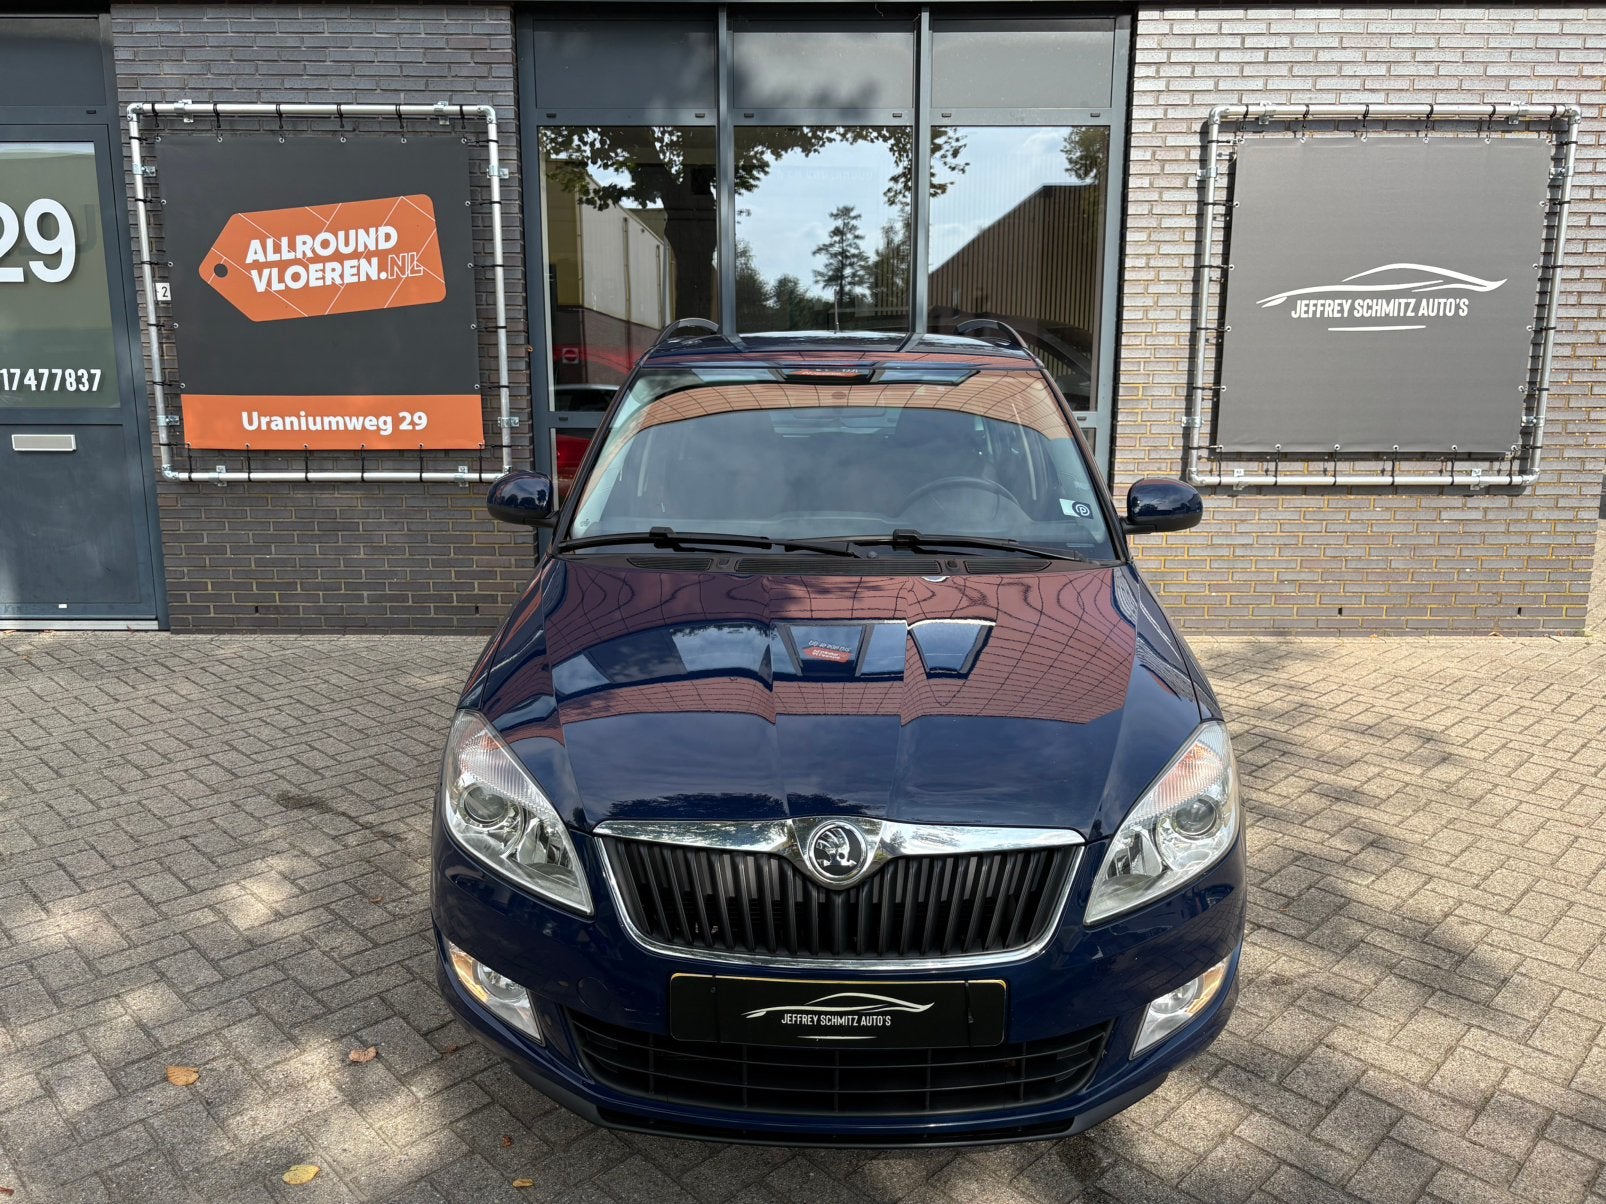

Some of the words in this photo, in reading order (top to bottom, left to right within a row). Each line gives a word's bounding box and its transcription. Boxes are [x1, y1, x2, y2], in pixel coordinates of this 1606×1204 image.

[245, 225, 398, 264] ALLROUND
[250, 251, 424, 293] VLOEREN.NL
[1291, 299, 1352, 318] JEFFREY
[1353, 298, 1416, 318] SCHMITZ
[1418, 298, 1469, 317] AUTO'S
[0, 368, 102, 391] 17477837
[241, 410, 393, 436] Uraniumweg
[398, 411, 428, 431] 29
[781, 1013, 818, 1025] JEFFREY
[820, 1014, 859, 1026] SCHMITZ
[860, 1015, 891, 1026] AUTO'S
